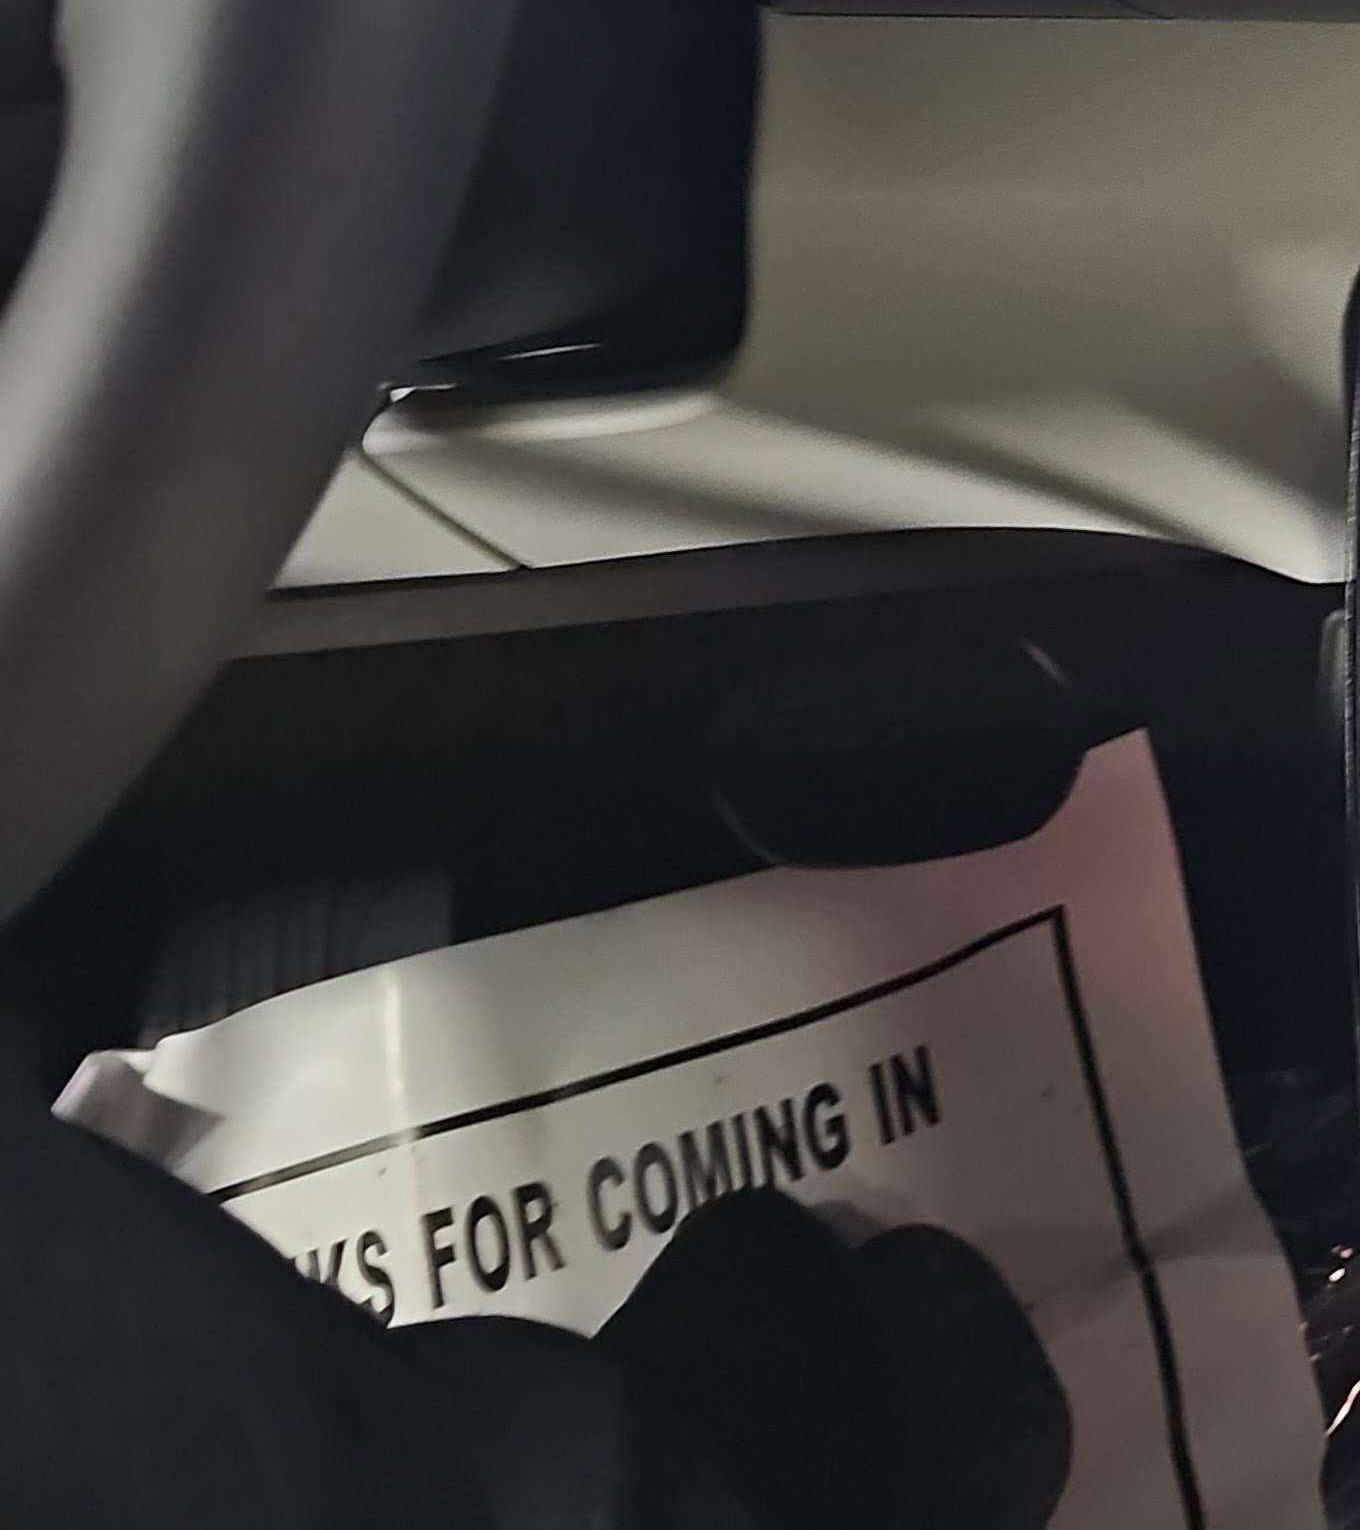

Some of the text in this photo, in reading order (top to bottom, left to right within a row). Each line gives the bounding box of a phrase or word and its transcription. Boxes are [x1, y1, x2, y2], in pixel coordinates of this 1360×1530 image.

[420, 1181, 568, 1311] FOR
[586, 1081, 852, 1253] COMING
[868, 1044, 943, 1147] IN
